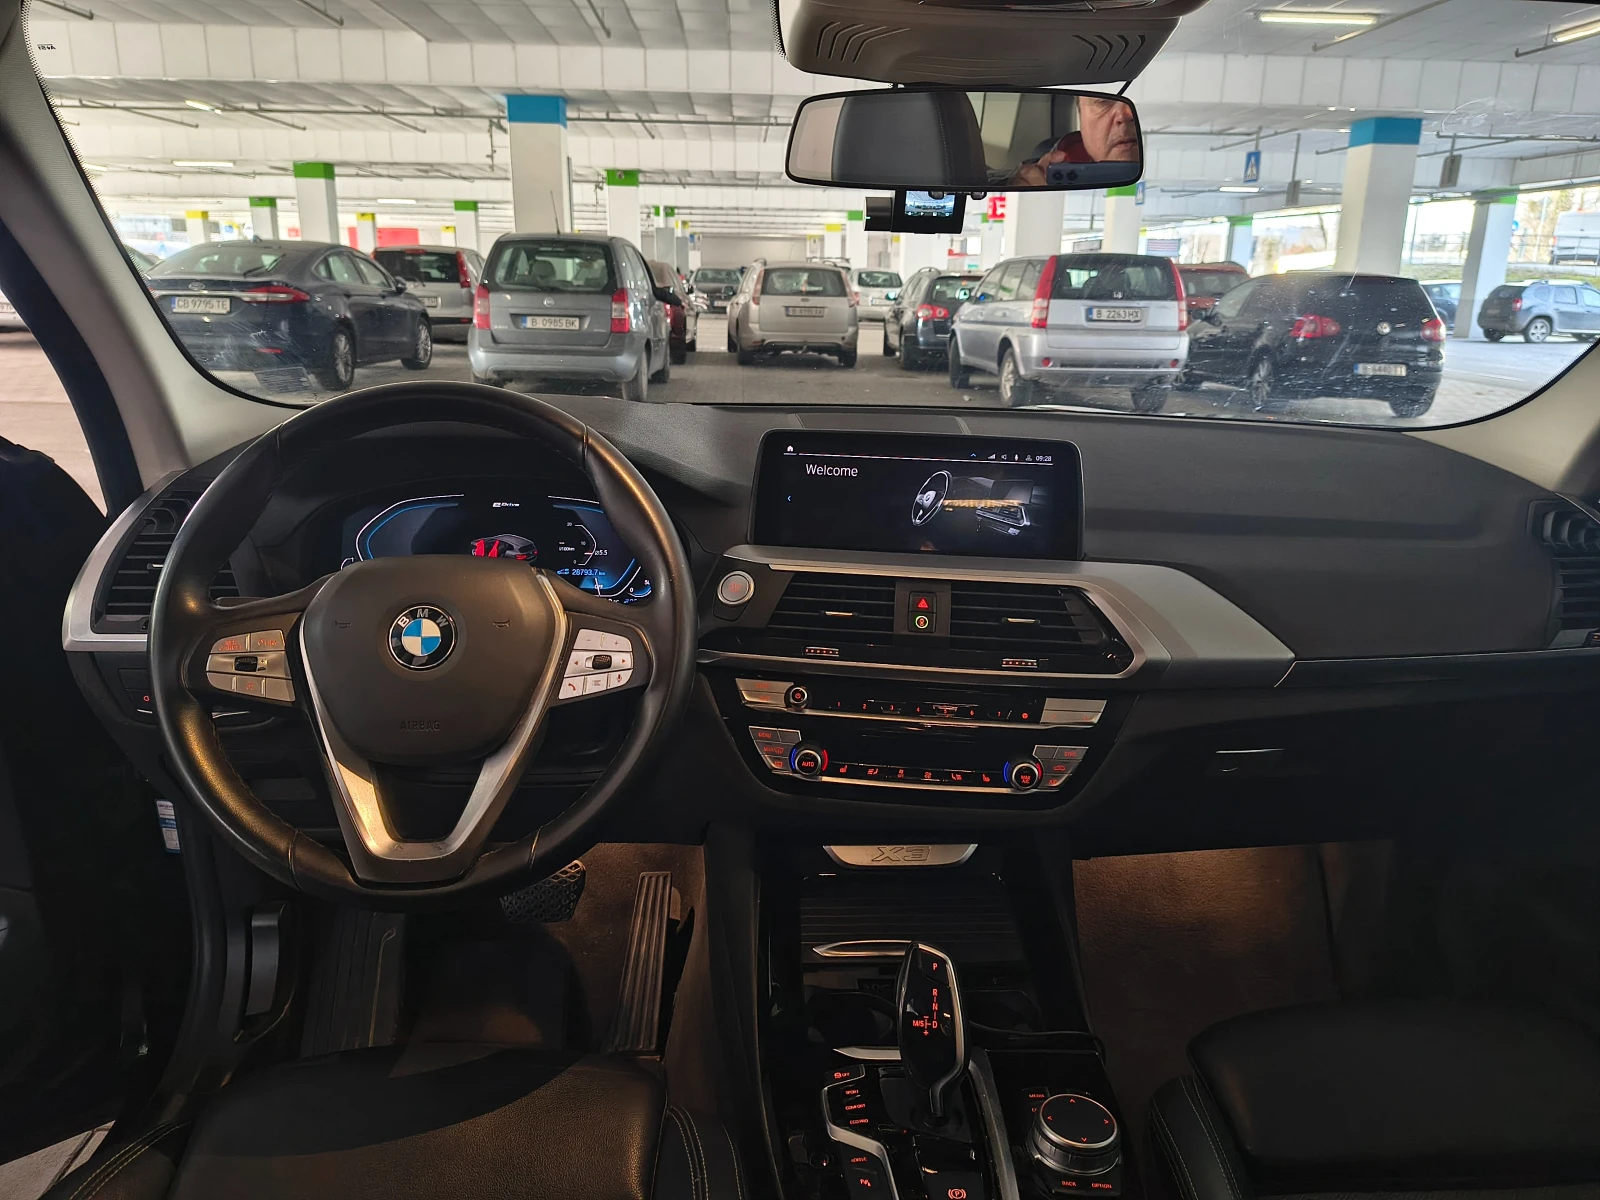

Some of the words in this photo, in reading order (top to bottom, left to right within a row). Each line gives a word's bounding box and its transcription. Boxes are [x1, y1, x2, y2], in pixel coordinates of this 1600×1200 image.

[177, 300, 189, 309] CB
[191, 300, 214, 309] 9795
[531, 318, 537, 326] B
[542, 318, 564, 328] 0985
[566, 320, 577, 328] BK
[806, 464, 858, 476] Welcome
[398, 608, 448, 628] BMW
[400, 720, 440, 731] AIRBAG
[871, 846, 930, 861] X3
